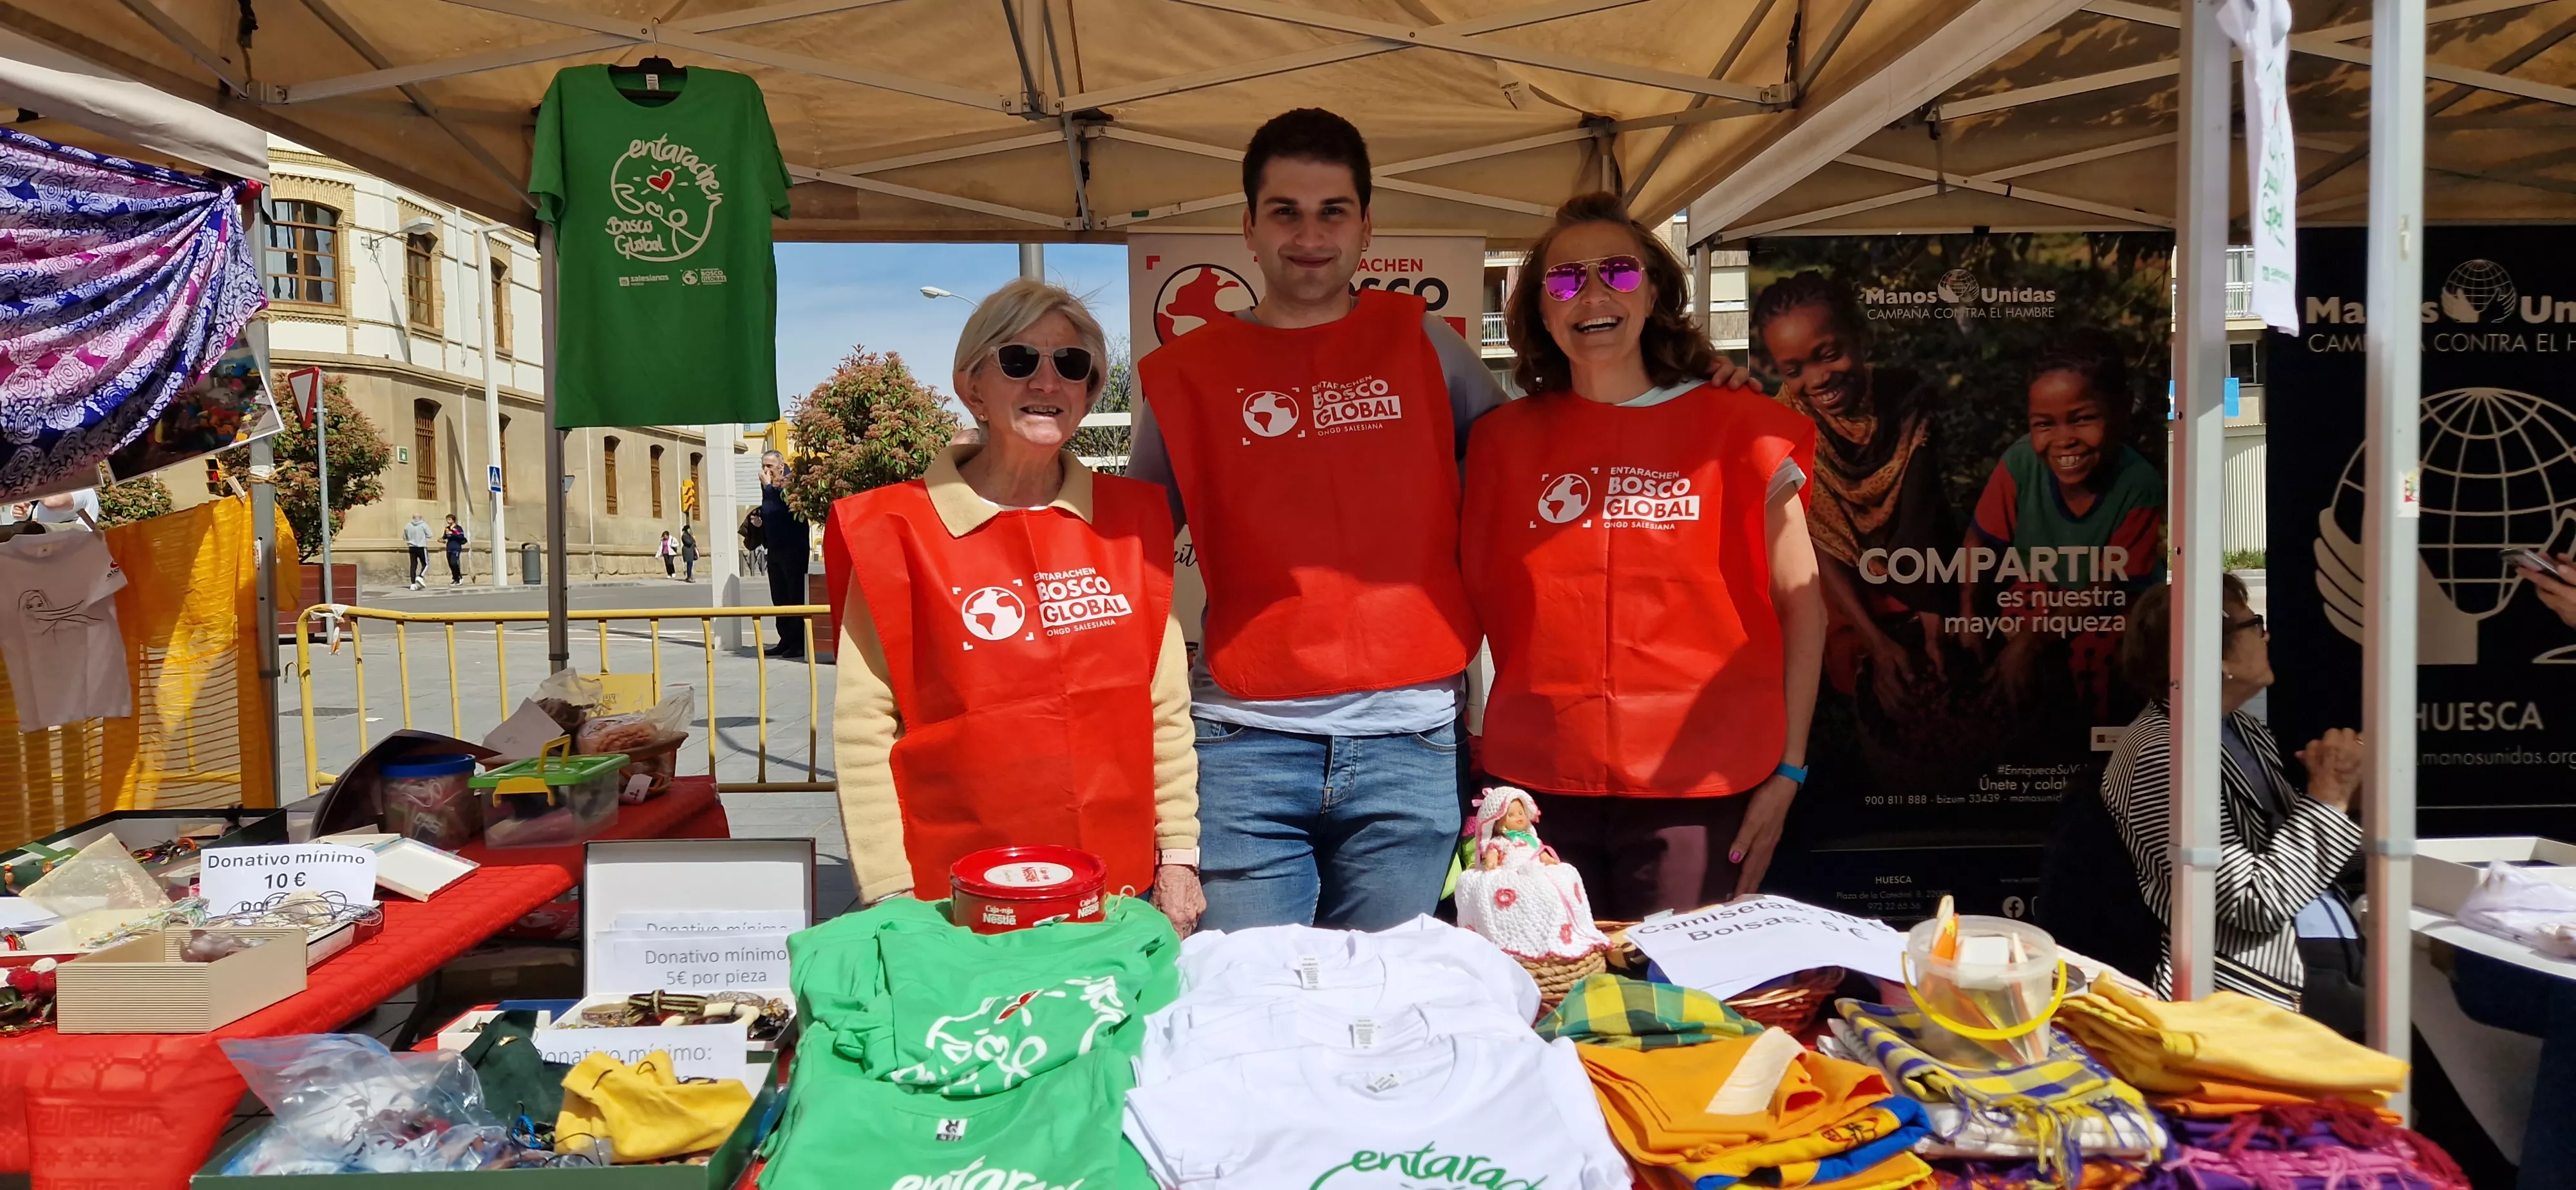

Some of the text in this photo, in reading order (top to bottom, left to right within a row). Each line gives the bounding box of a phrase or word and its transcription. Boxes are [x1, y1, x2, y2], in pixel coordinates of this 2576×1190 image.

[605, 216, 653, 235] Bosco
[614, 234, 667, 260] Global
[1357, 258, 1423, 272] ACHEN
[1866, 288, 2056, 304] Manos Unidas
[1868, 306, 1930, 319] CAMPAÑA
[1991, 307, 2002, 318] EL
[2006, 307, 2054, 317] HAMBRE
[2306, 297, 2439, 323] Mas
[2434, 334, 2527, 352] CONTRA
[2537, 334, 2558, 352] EL
[1313, 379, 1388, 408] BOSCO
[1316, 400, 1398, 426] GLOBAL
[1318, 422, 1383, 437] ONGD SALESIANA
[1611, 466, 1680, 479] ENTARACHEN
[1608, 477, 1690, 498] BOSCO
[1607, 498, 1695, 518] GLOBAL
[1631, 522, 1675, 530] SALESIANA
[1034, 567, 1096, 581] ENTARACHEN
[1859, 546, 2129, 584] COMPARTIR
[1036, 576, 1111, 601] BOSCO
[1997, 586, 2125, 607] es nuestra
[1043, 599, 1127, 623] GLOBAL
[1047, 619, 1116, 636] ONGD SALESIANA
[1945, 609, 2125, 639] mayor riqueza
[1979, 774, 2017, 790] Únete
[2022, 781, 2029, 793] y
[1865, 796, 1884, 804] 900
[1888, 796, 1902, 804] 811
[1908, 795, 1927, 804] 888
[1969, 794, 2000, 803] 33439
[208, 851, 365, 868] Donativo mínimo
[265, 872, 306, 889] 10 €
[1687, 915, 1812, 941] Bolsas:
[1821, 914, 1840, 932] 5
[645, 947, 786, 964] Donativo mínimo
[667, 970, 766, 987] 5€ por pieza
